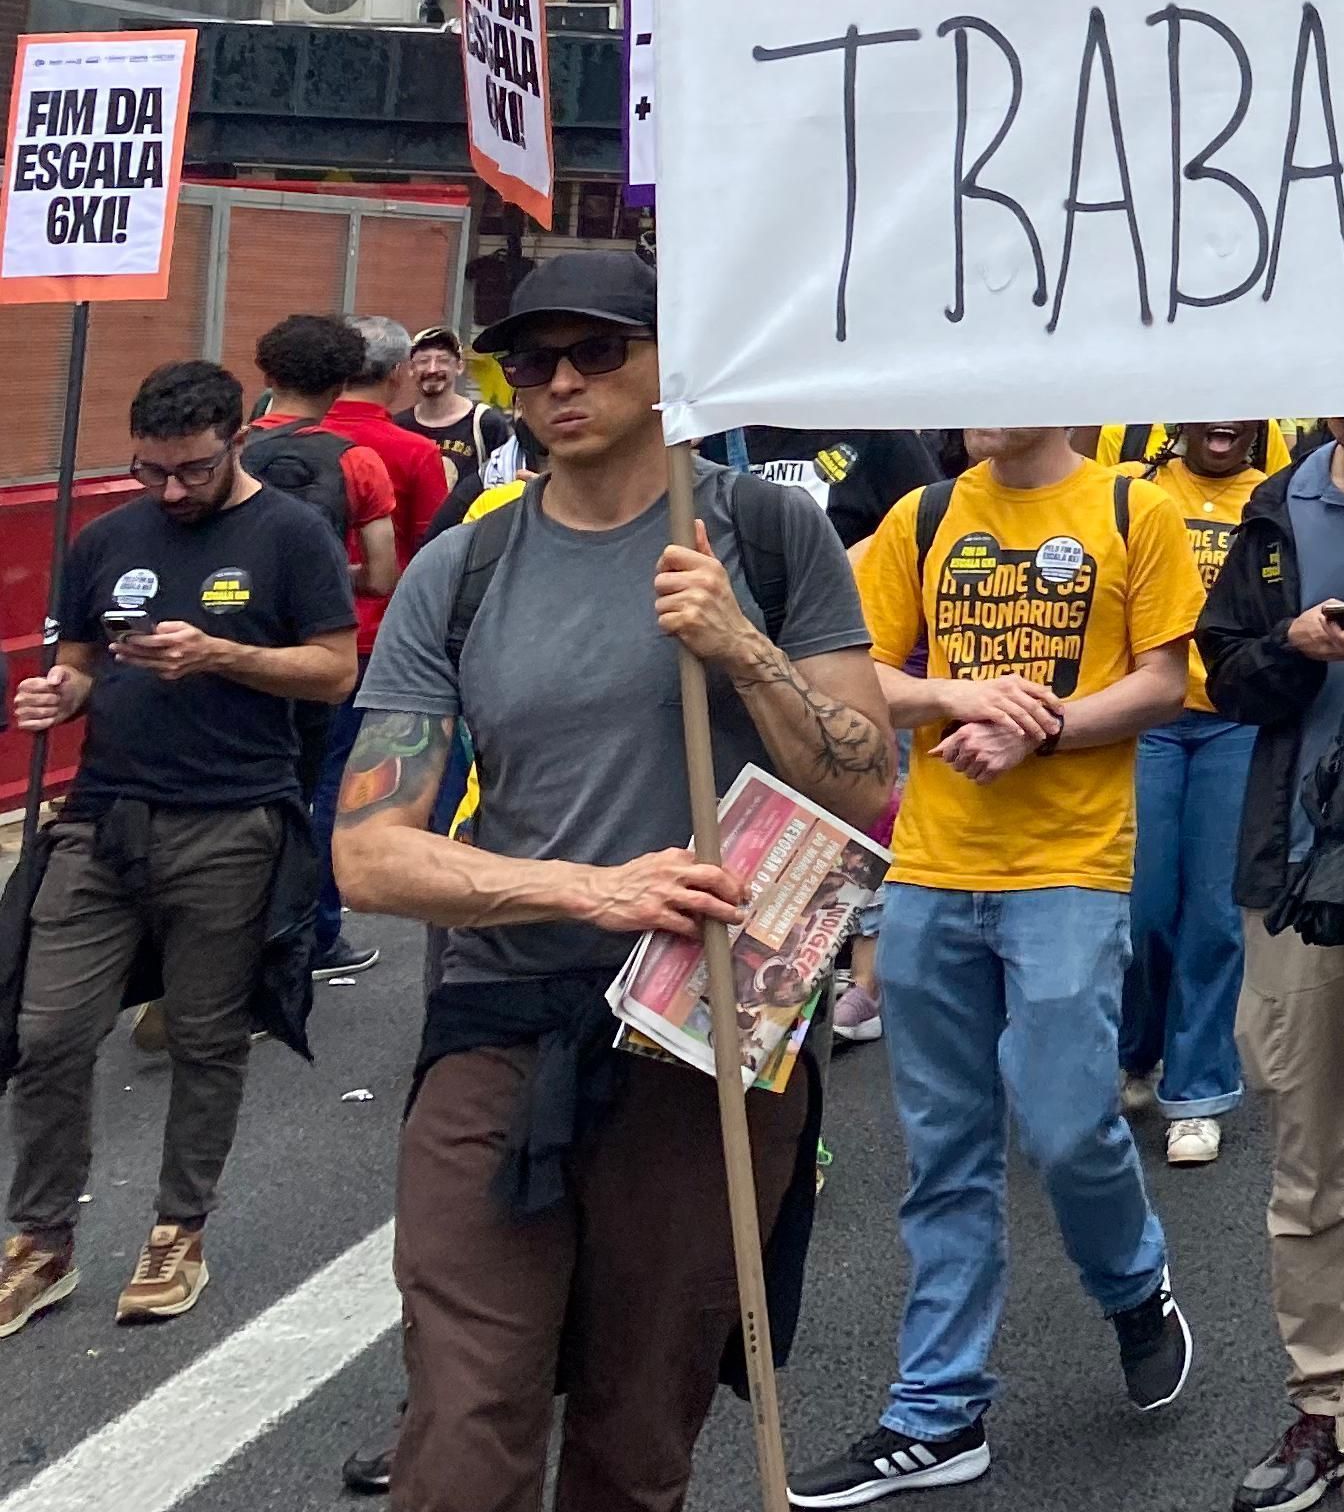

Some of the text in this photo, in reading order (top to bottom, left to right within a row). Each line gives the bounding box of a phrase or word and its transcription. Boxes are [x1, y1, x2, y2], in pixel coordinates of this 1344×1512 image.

[26, 87, 163, 138] FIM DA
[13, 141, 163, 192] ESCALA
[46, 194, 131, 245] 6X1!
[762, 462, 804, 482] ANTI
[939, 592, 1087, 630] BILIONÁRIOS
[980, 626, 1081, 663] DEVERIAM
